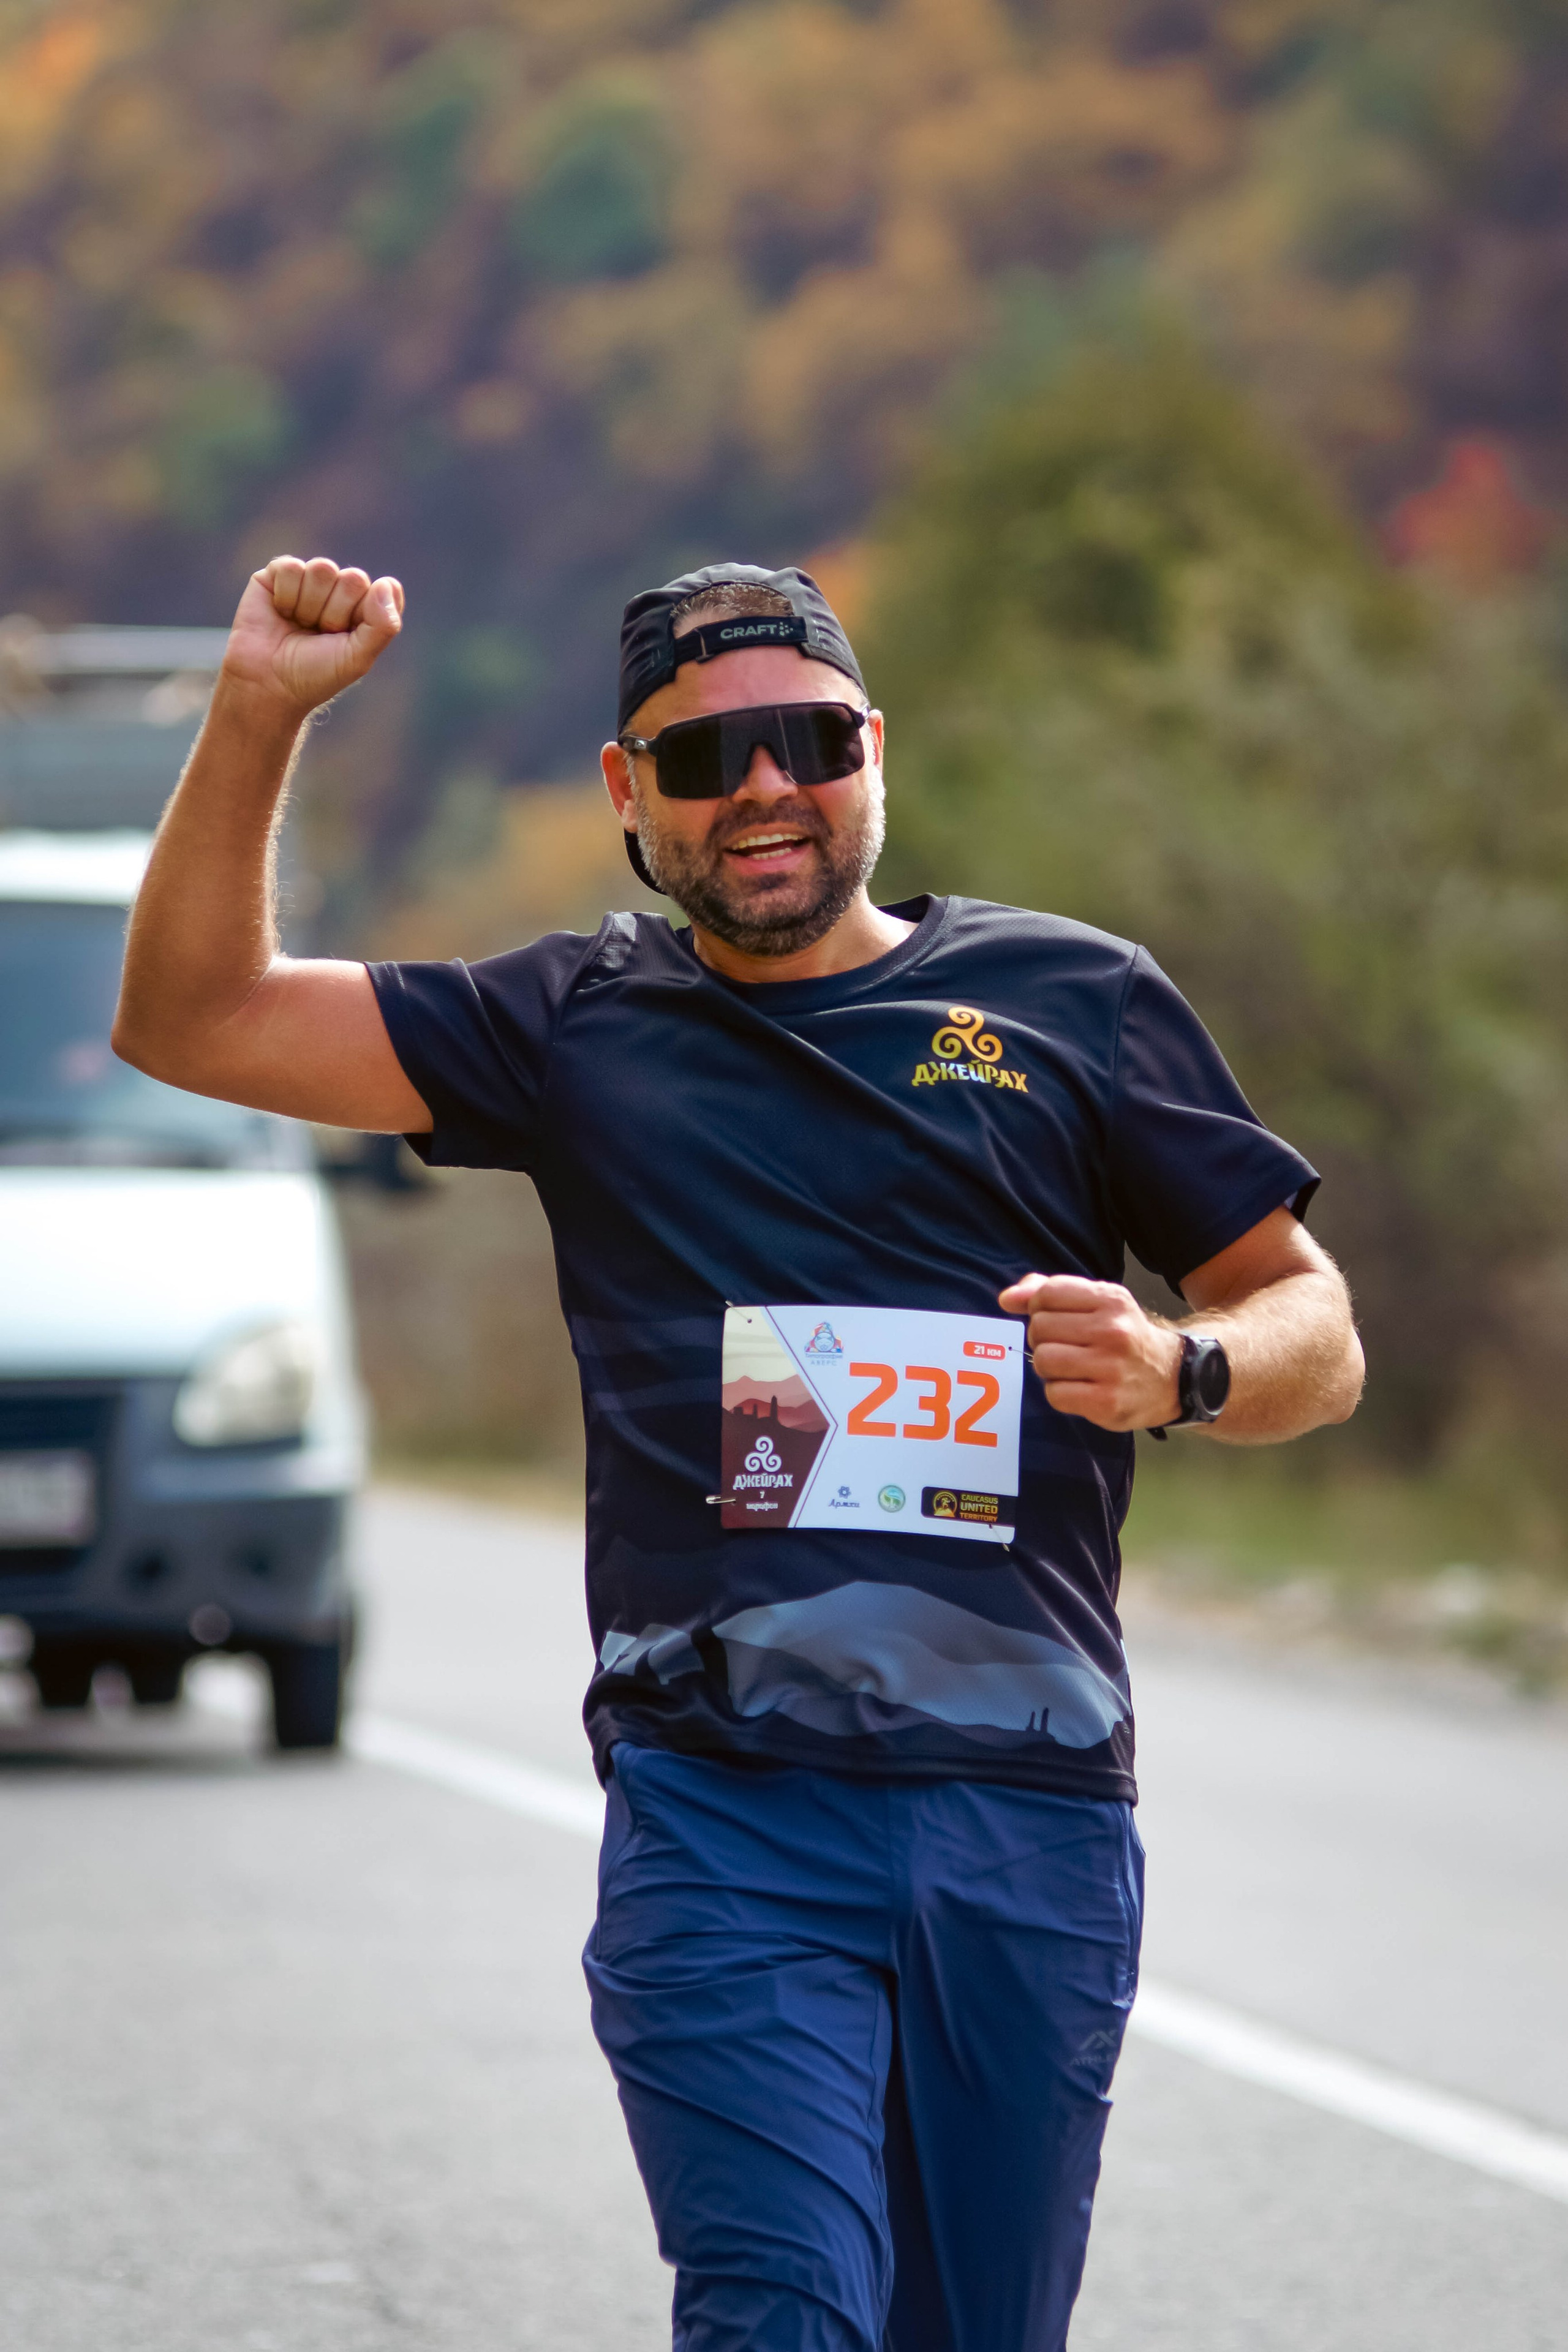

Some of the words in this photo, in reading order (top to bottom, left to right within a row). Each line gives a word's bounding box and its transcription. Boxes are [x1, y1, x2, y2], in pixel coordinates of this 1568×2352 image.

[720, 625, 777, 639] CRAFT
[911, 1060, 1029, 1093] ДЖЕЙРАХ
[974, 1345, 985, 1355] 21
[847, 1362, 1000, 1448] 232
[733, 1472, 793, 1490] ДЖЕЙРАХ
[760, 1490, 765, 1499] 7
[961, 1494, 998, 1504] CAUCASUS
[960, 1502, 998, 1514] UNITED
[959, 1512, 998, 1523] TERRITORY
